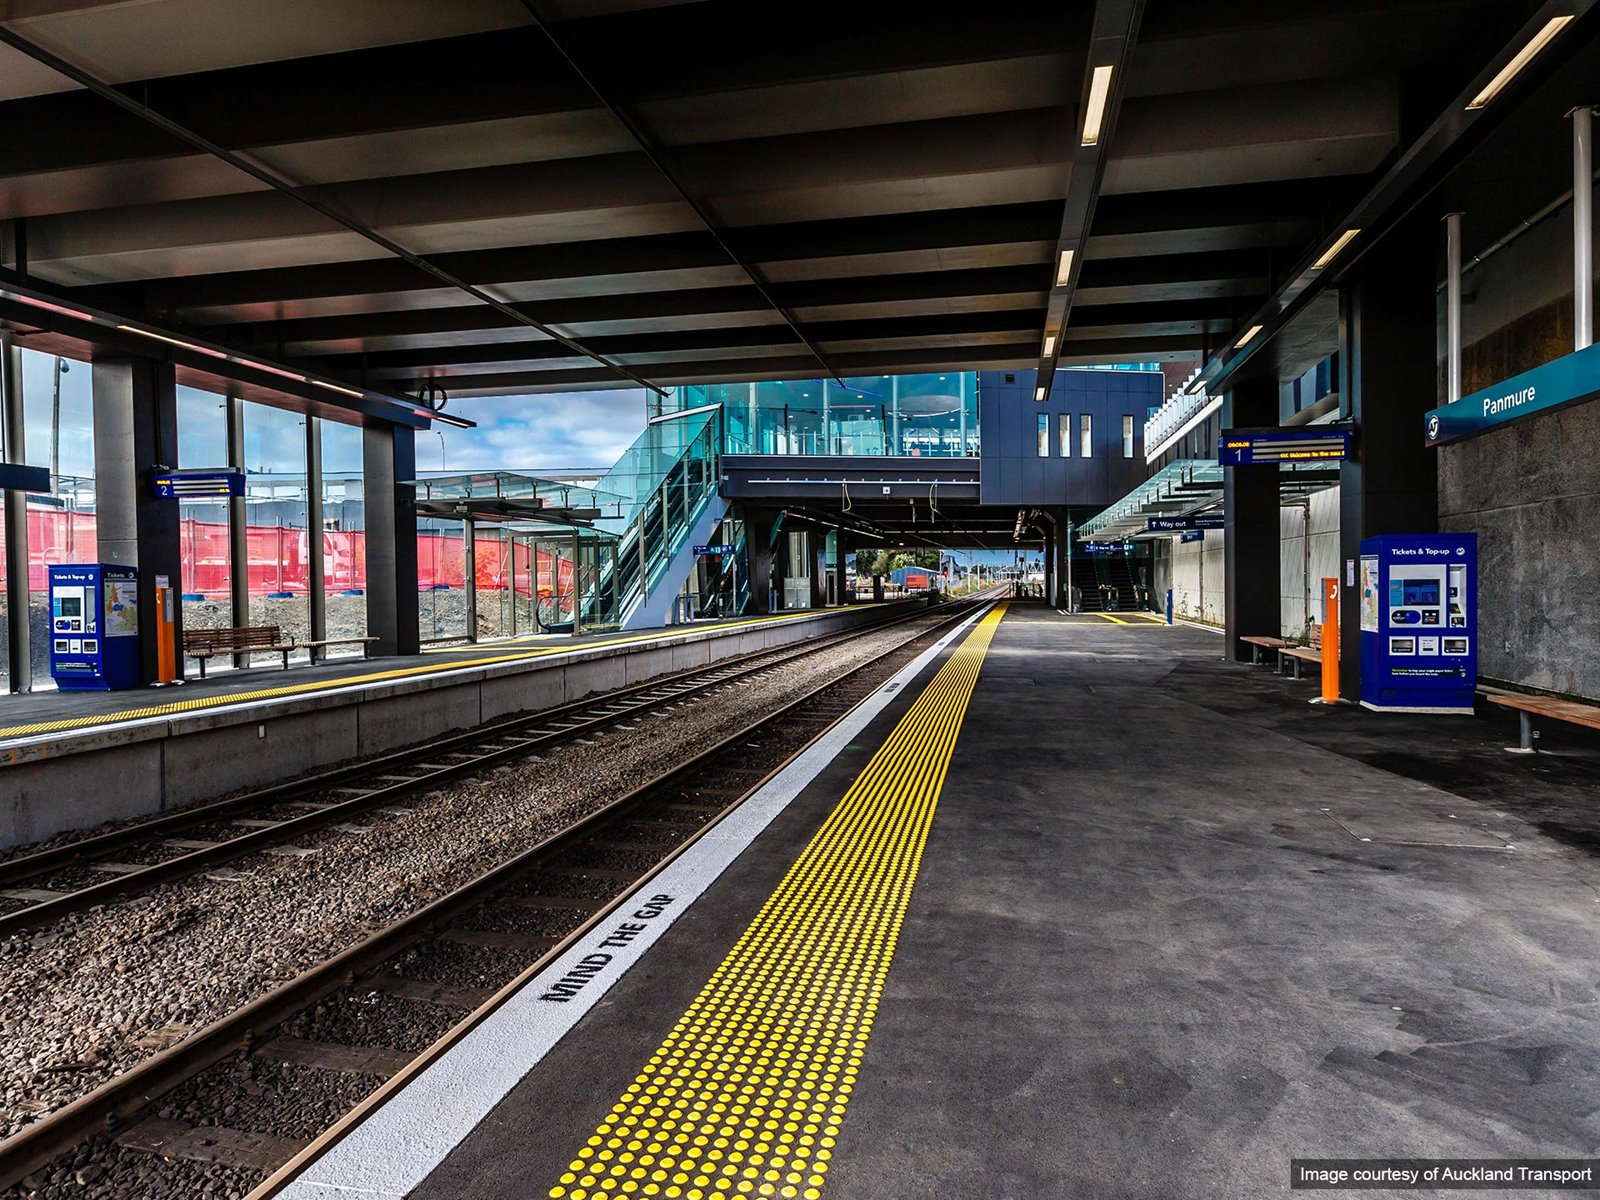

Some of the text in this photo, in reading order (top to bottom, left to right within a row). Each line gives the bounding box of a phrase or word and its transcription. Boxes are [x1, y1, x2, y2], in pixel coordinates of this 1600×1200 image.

[1483, 386, 1536, 417] Panmure
[1235, 449, 1241, 461] 1
[160, 485, 168, 496] 2
[1425, 548, 1450, 556] Top-up
[539, 894, 675, 1003] MIND THE GAP
